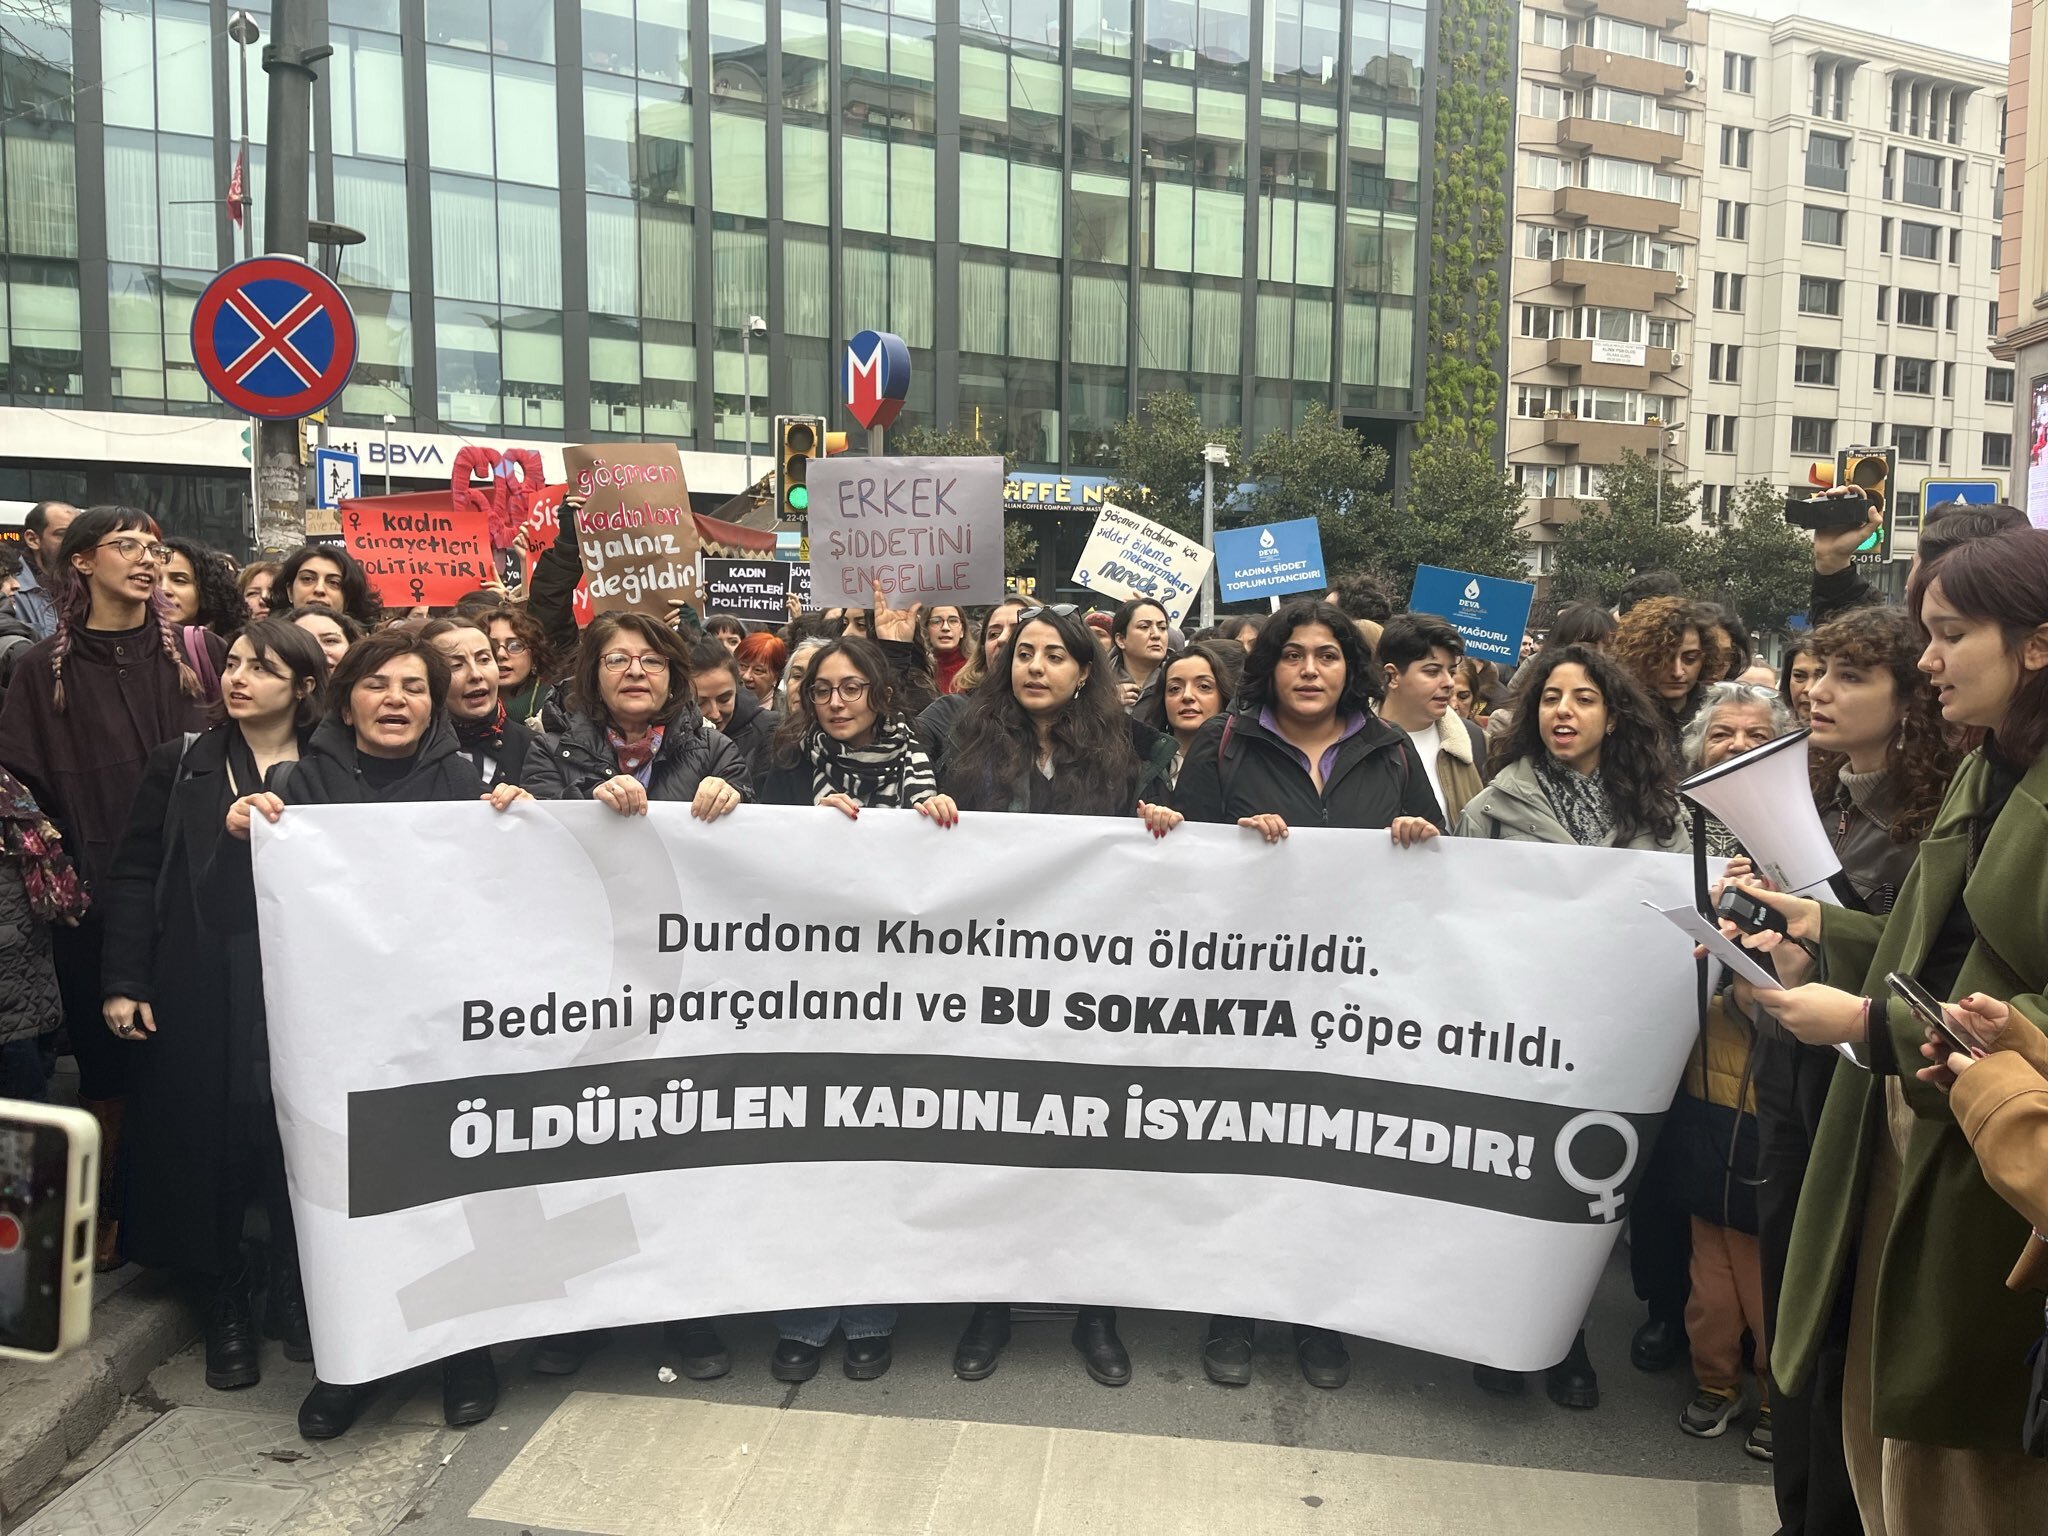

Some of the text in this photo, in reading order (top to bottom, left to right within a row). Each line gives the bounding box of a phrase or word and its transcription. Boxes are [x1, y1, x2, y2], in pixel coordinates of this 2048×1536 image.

[368, 442, 444, 465] BBVA
[577, 458, 678, 498] göçmen
[838, 478, 957, 519] ERKEK
[1003, 477, 1071, 503] AFFÈ
[382, 511, 453, 533] kadın
[576, 500, 683, 534] kadınlar
[786, 514, 808, 522] 22-01
[355, 532, 480, 555] cinayetleri
[829, 523, 972, 560] ŞİDDETİNİ
[1101, 509, 1198, 561] göçmen kadınlar için
[583, 532, 681, 571] yalnız
[1096, 527, 1172, 567] şiddet önleme
[1258, 548, 1279, 557] DEVA
[1850, 554, 1882, 563] 2-016
[590, 551, 703, 605] değildir!
[729, 567, 767, 578] KADIN
[791, 567, 810, 577] GÜV
[841, 562, 971, 595] ENGELLE
[1119, 549, 1194, 595] mekanizmaları
[1234, 560, 1307, 578] KADINA ŞİDDET
[709, 580, 784, 596] CİNAYETLERİ
[1226, 579, 1267, 591] TOPLUM
[711, 596, 784, 611] POLİTİKTİR!
[1458, 599, 1480, 609] DEVA
[1457, 625, 1508, 642] MAĞDURU
[1465, 639, 1512, 656] NINDAYIZ.
[659, 914, 1378, 977] Durdona Khokimova öldürüldü.
[463, 981, 1575, 1072] Bedeni parçalandı ve BU SOKAKTA çöpe atıldı.
[450, 1078, 1535, 1180] ÖLDÜRÜLEN KADINLAR İSYANIMIZDIR!
